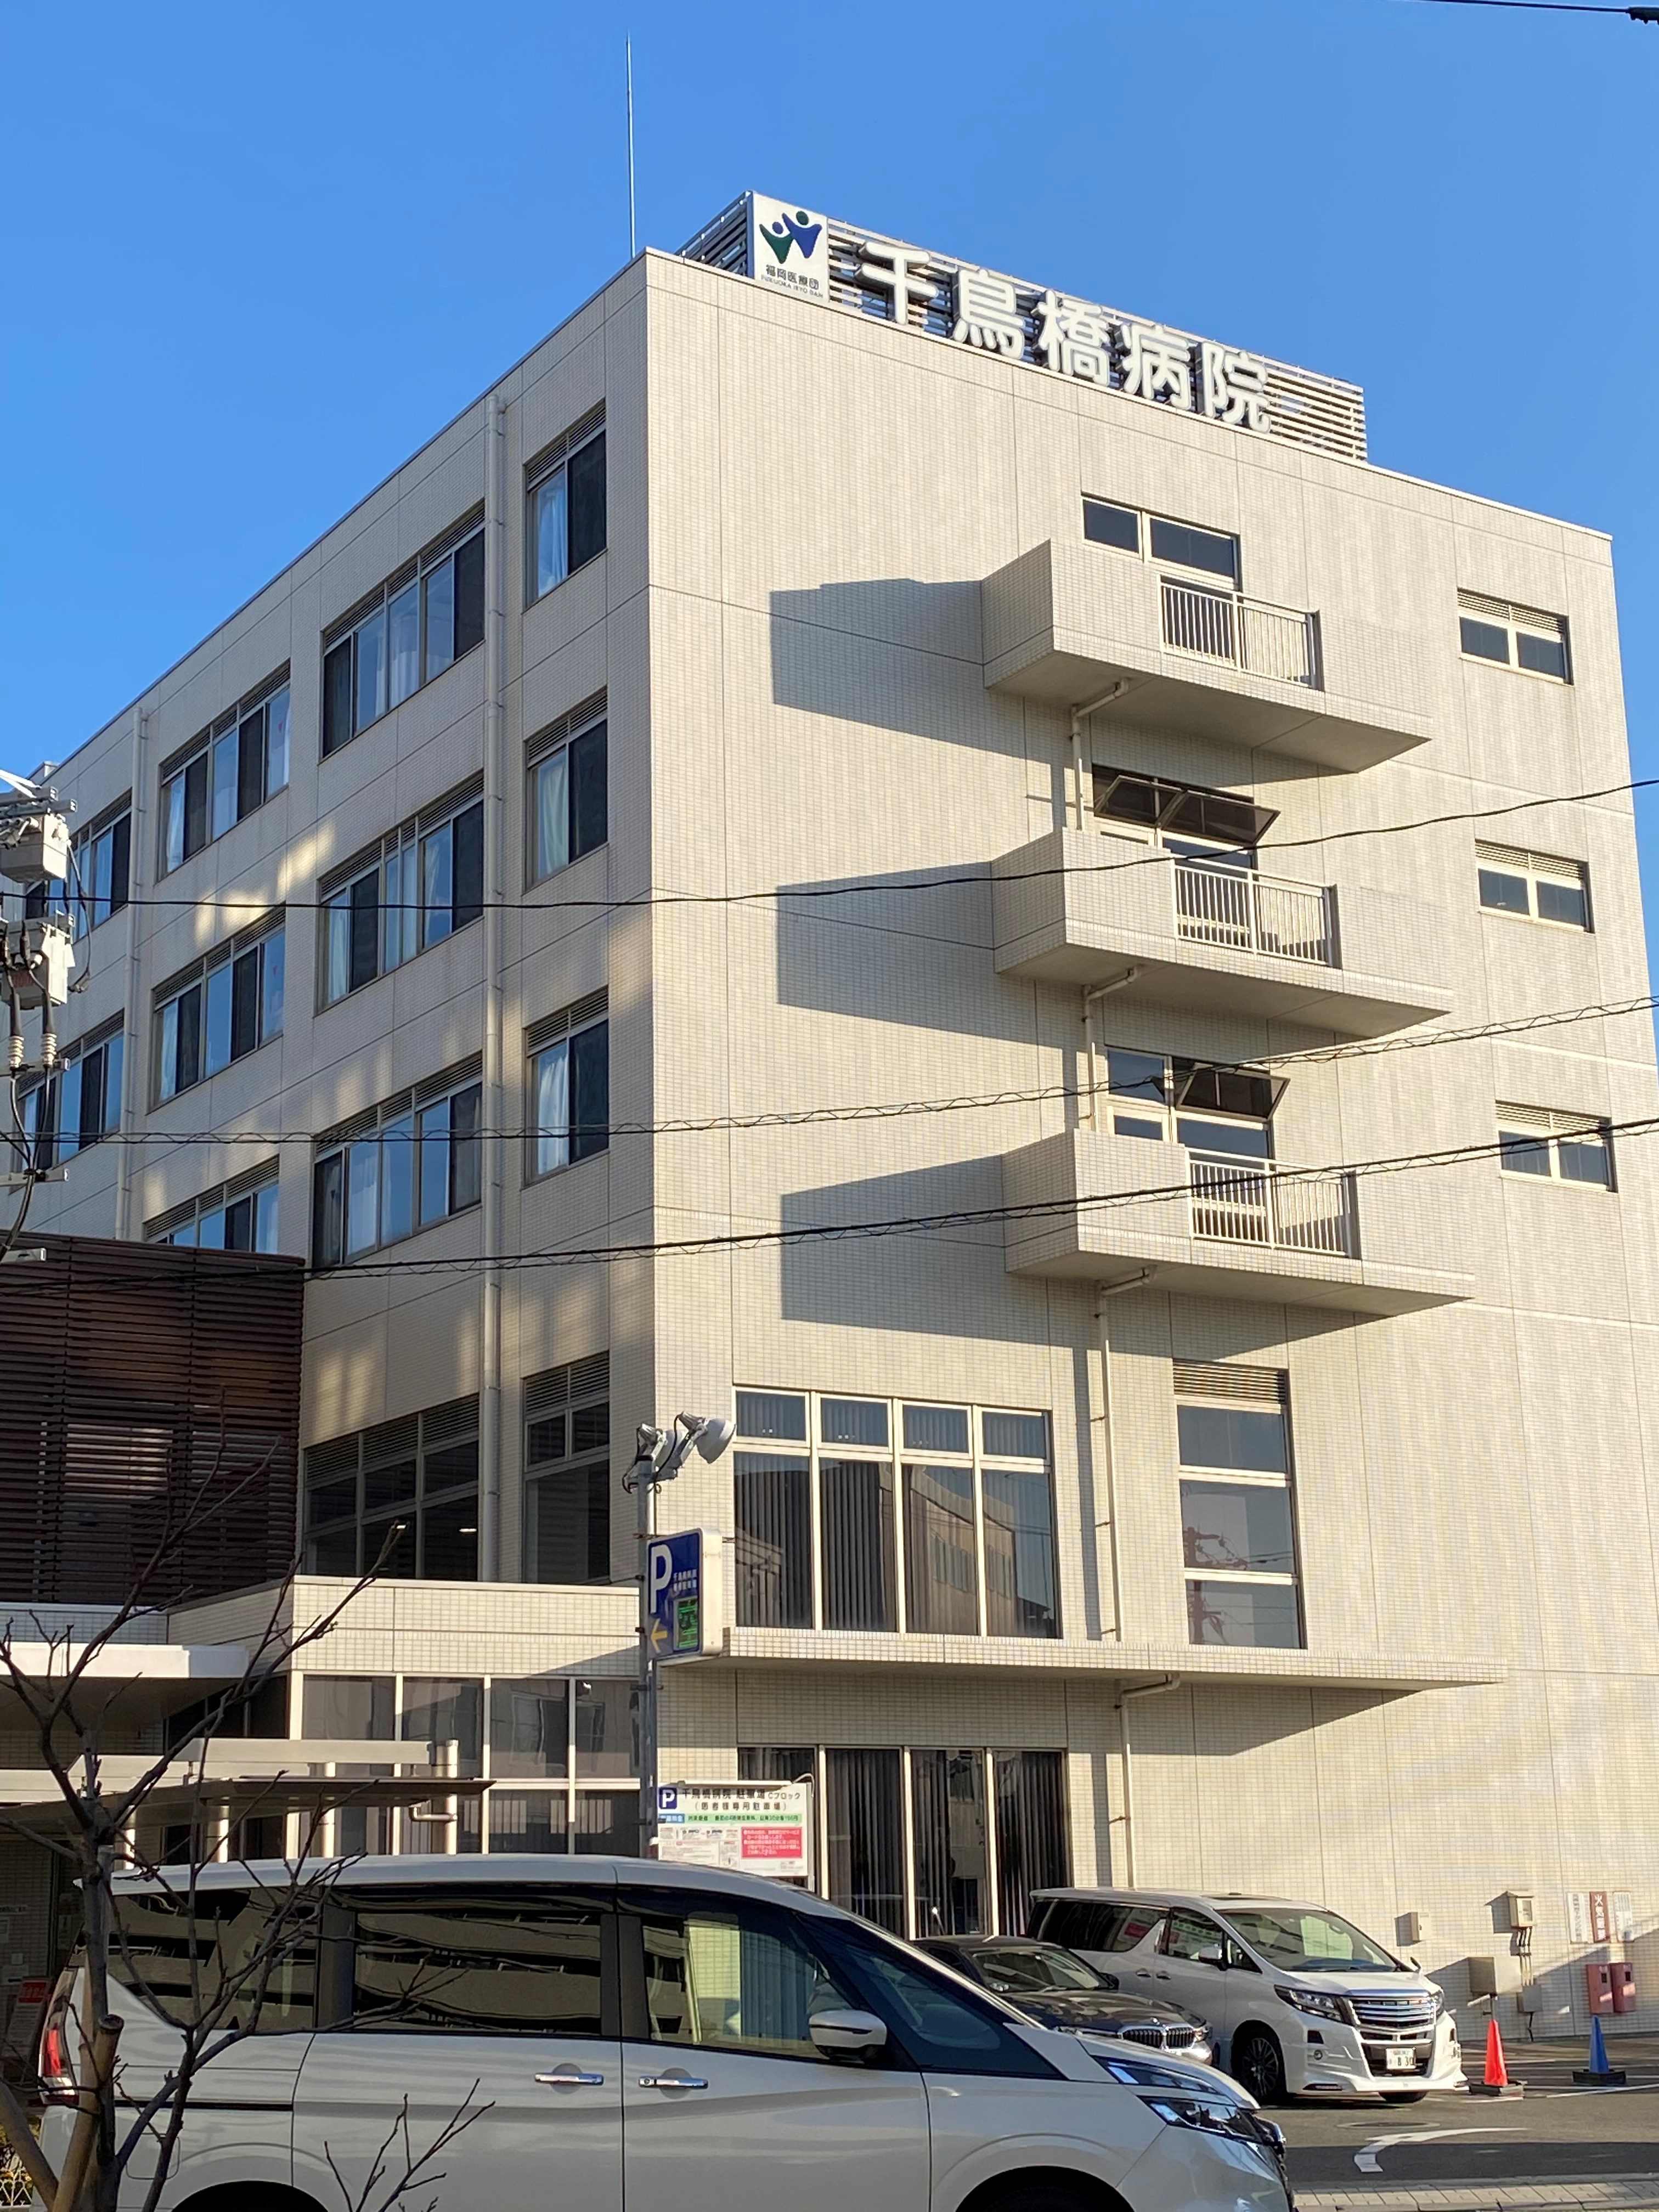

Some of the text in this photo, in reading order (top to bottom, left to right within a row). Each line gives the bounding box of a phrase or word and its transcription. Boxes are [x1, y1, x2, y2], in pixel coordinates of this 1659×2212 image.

[766, 264, 819, 290] 福岡医療団
[857, 241, 1271, 433] 千鳥橋病院
[650, 1544, 673, 1614] P
[662, 1789, 675, 1808] P
